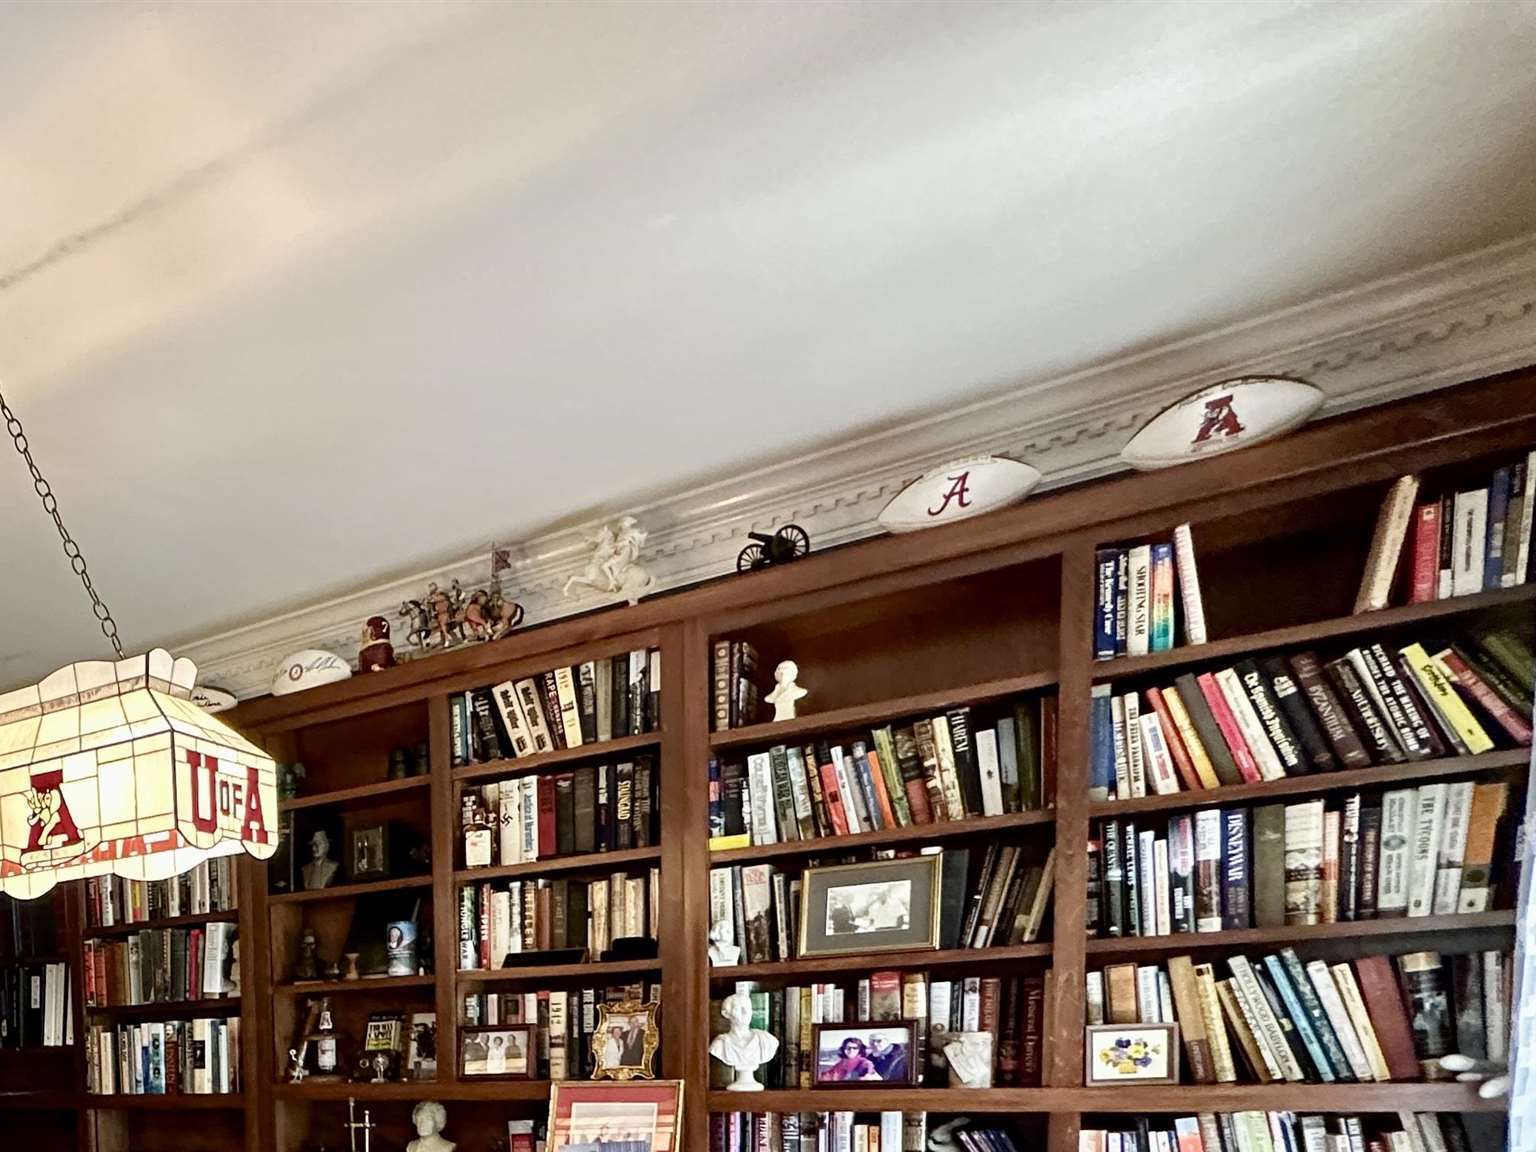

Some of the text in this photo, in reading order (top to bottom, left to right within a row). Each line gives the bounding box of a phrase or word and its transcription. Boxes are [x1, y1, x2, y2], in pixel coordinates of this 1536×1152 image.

[928, 472, 972, 516] A
[1134, 565, 1147, 637] SHOOTING STAR
[544, 671, 560, 699] RAPE
[1307, 684, 1344, 741] BYZANTIUM
[1398, 696, 1422, 728] MAKING
[950, 715, 969, 753] HAREM
[1384, 696, 1406, 728] ATOMIC
[1400, 727, 1421, 752] BOMB
[26, 768, 85, 851] A
[617, 779, 632, 821] STALINGRAD
[1125, 825, 1137, 886] MICHAEL LEWIS
[1417, 796, 1436, 861] THE TYCOONS
